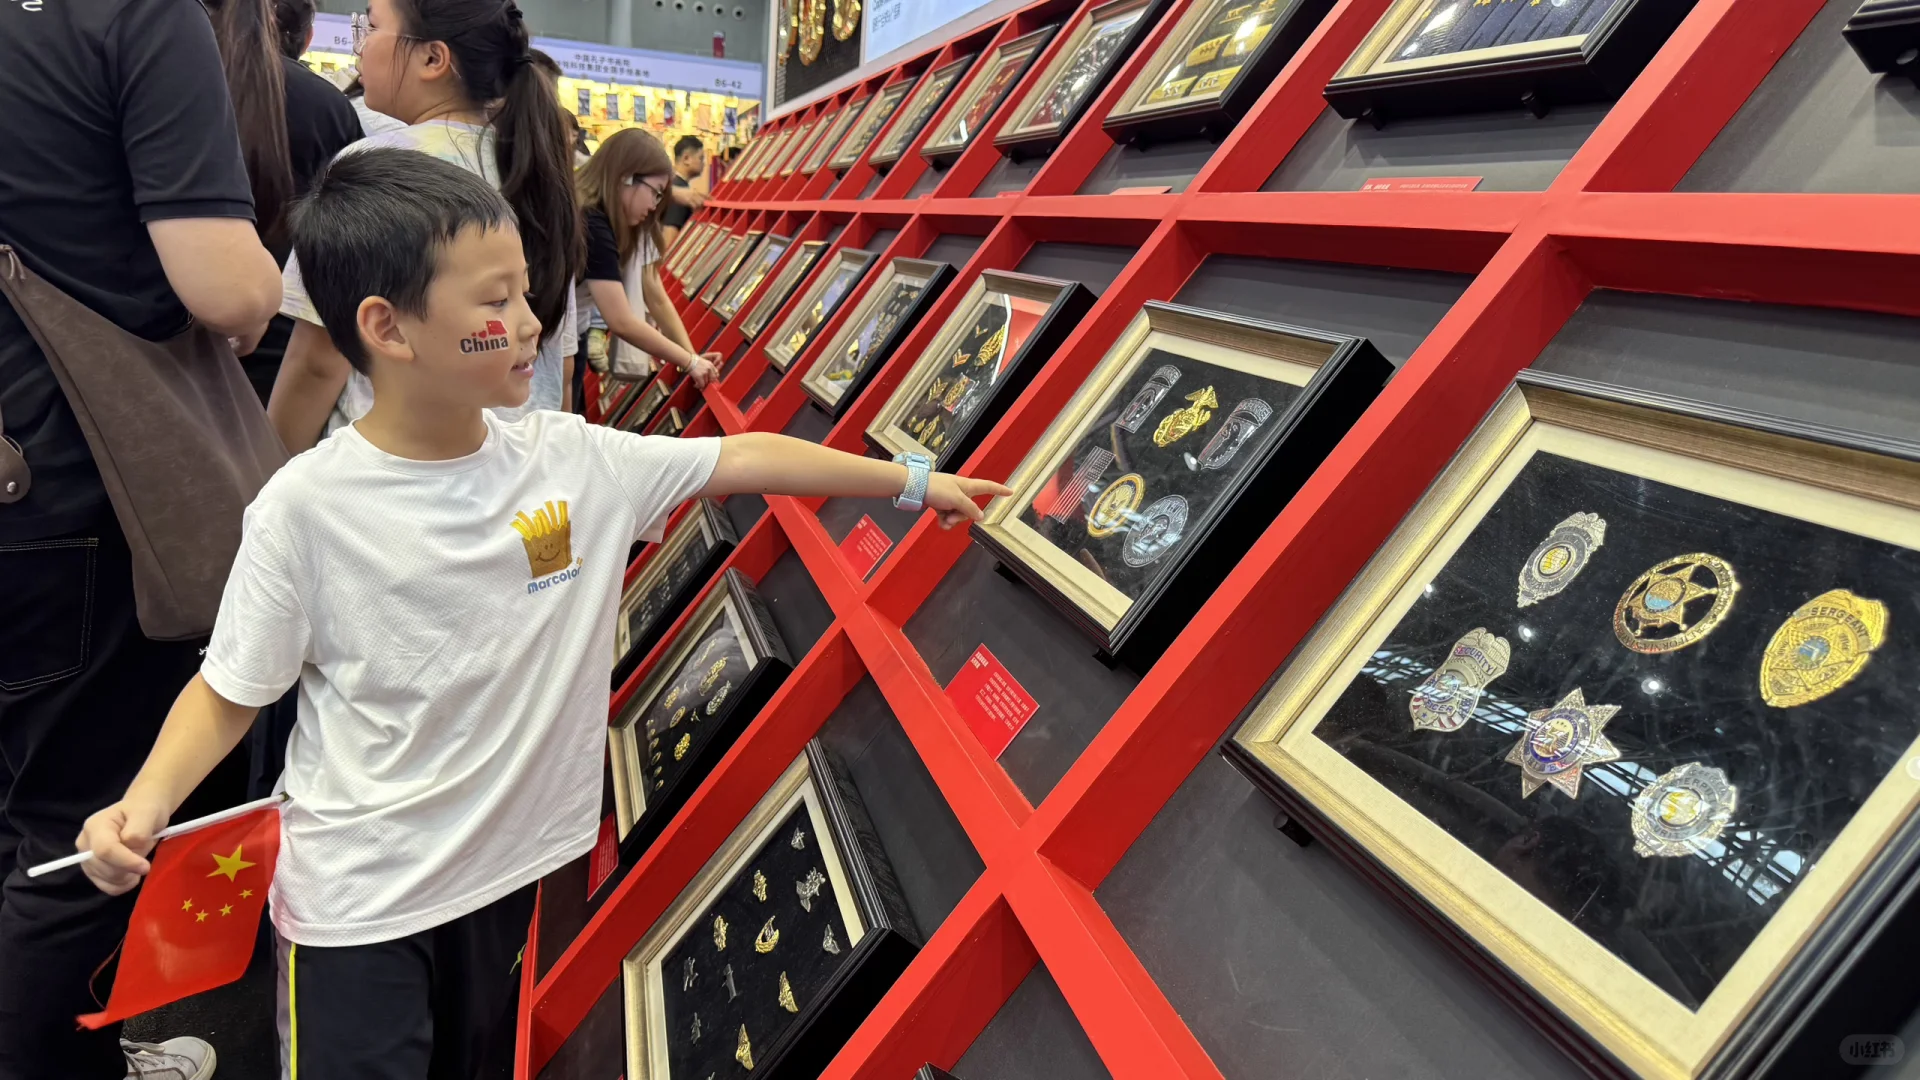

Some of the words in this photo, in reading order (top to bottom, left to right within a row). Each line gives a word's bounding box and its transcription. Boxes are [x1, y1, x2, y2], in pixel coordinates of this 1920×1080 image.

[334, 36, 354, 46] B6-
[714, 78, 743, 90] B6-42
[460, 336, 509, 353] China
[1811, 606, 1869, 638] SERGEANT
[1454, 645, 1495, 673] SECURITY
